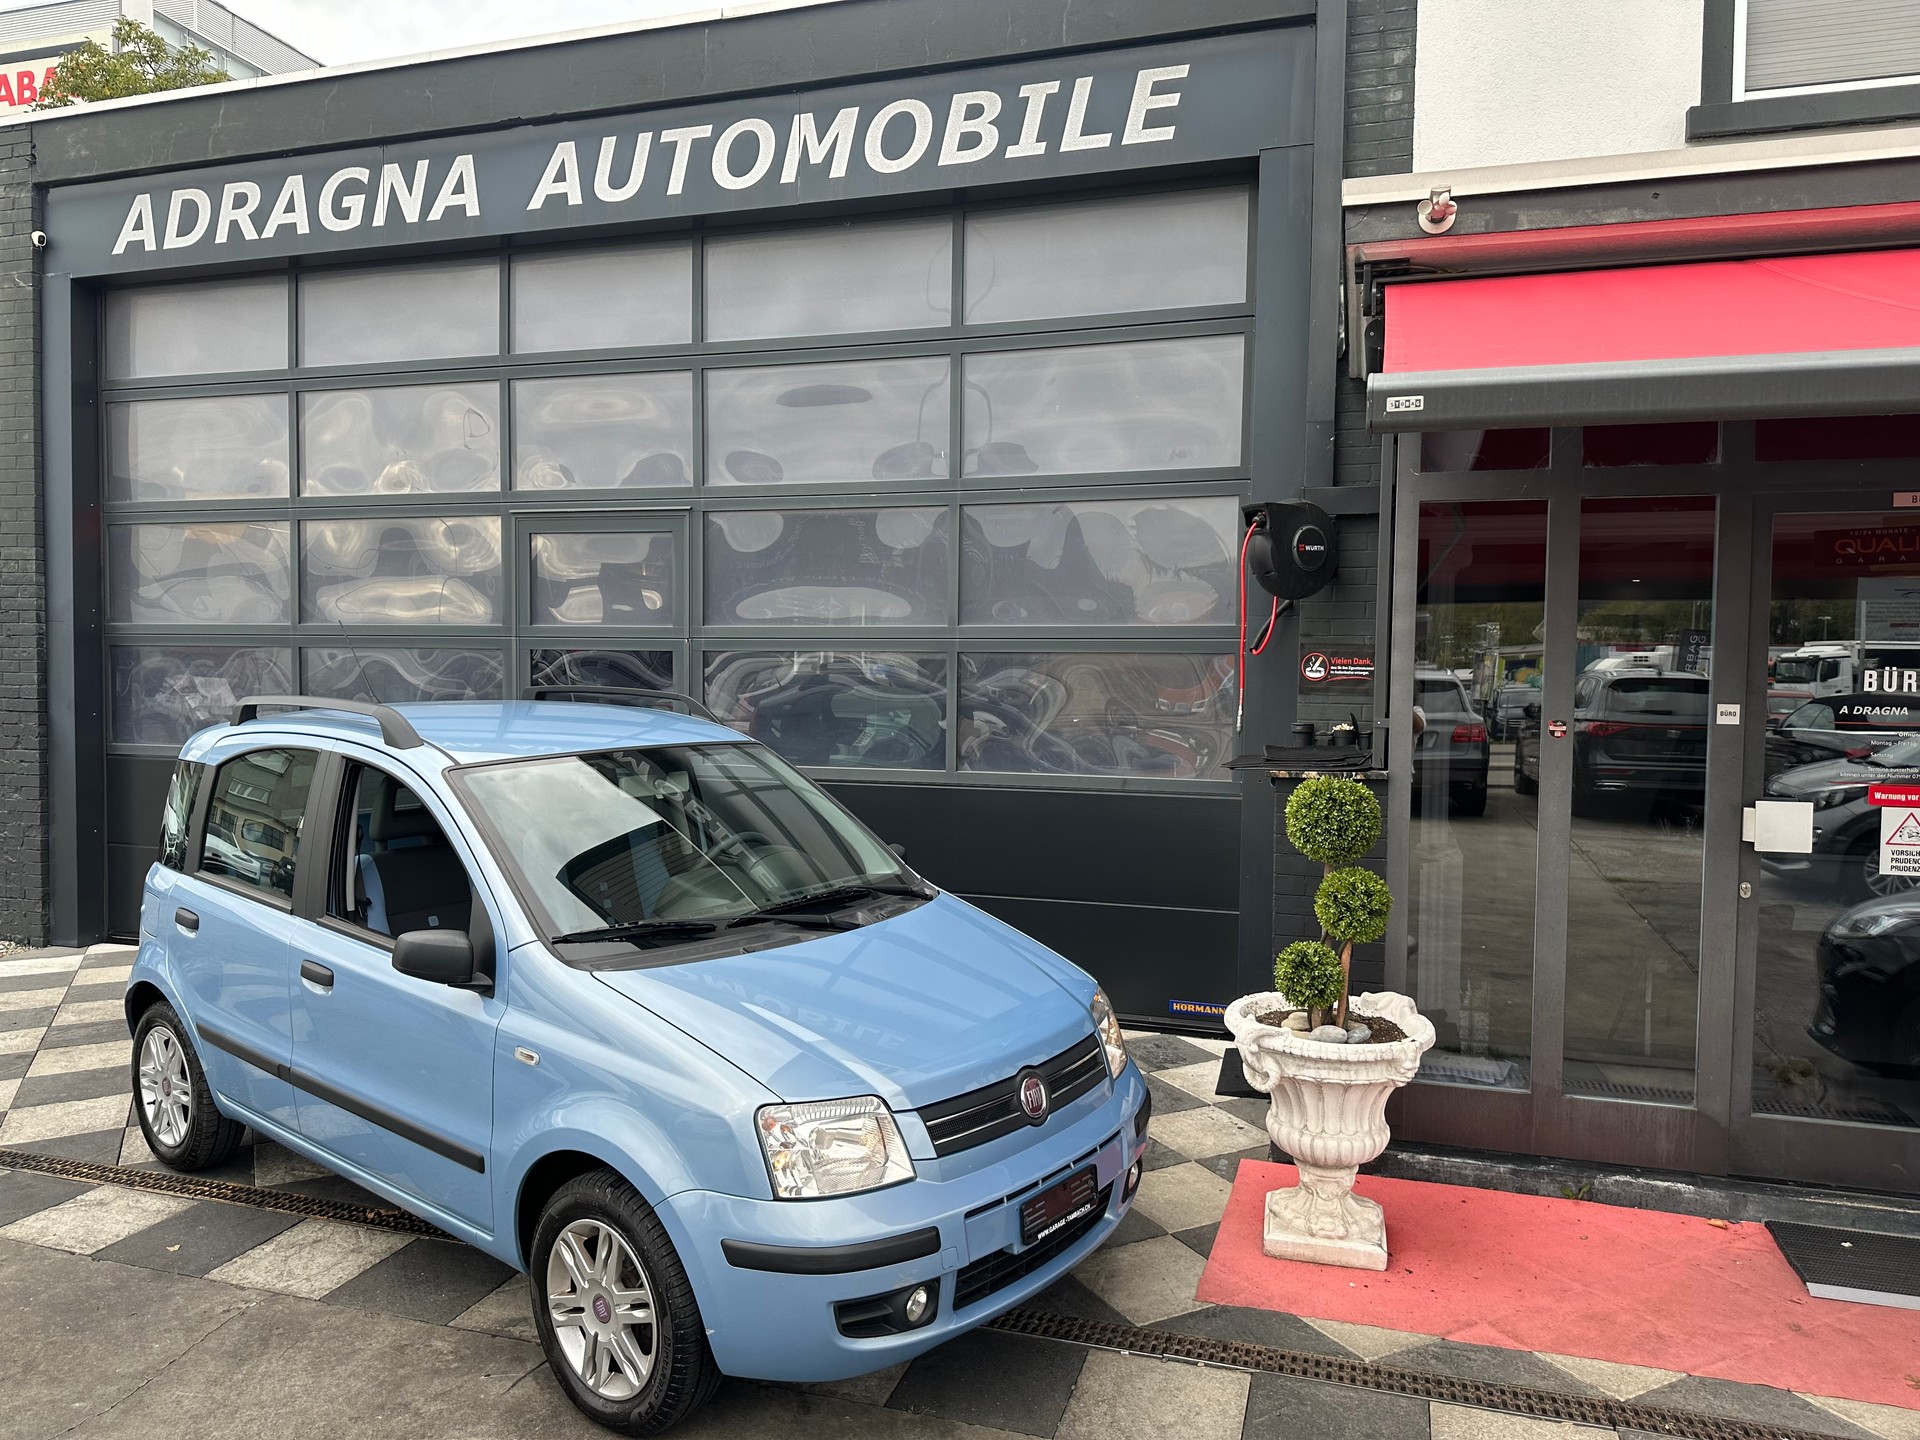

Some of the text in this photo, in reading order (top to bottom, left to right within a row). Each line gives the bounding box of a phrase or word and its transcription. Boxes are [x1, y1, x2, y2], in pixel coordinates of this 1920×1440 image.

[111, 63, 1190, 256] ADRAGNA AUTOMOBILE
[1390, 399, 1421, 408] STOBAG
[1875, 527, 1908, 535] MONATE
[1330, 656, 1374, 666] Vielen Dank,
[1863, 666, 1918, 693] BÜR
[1852, 705, 1909, 716] DRAGNA
[1874, 791, 1920, 801] Warnung vor
[1891, 849, 1920, 857] VORSICH
[1026, 1086, 1042, 1109] FIAT
[595, 1300, 608, 1317] FIAT
